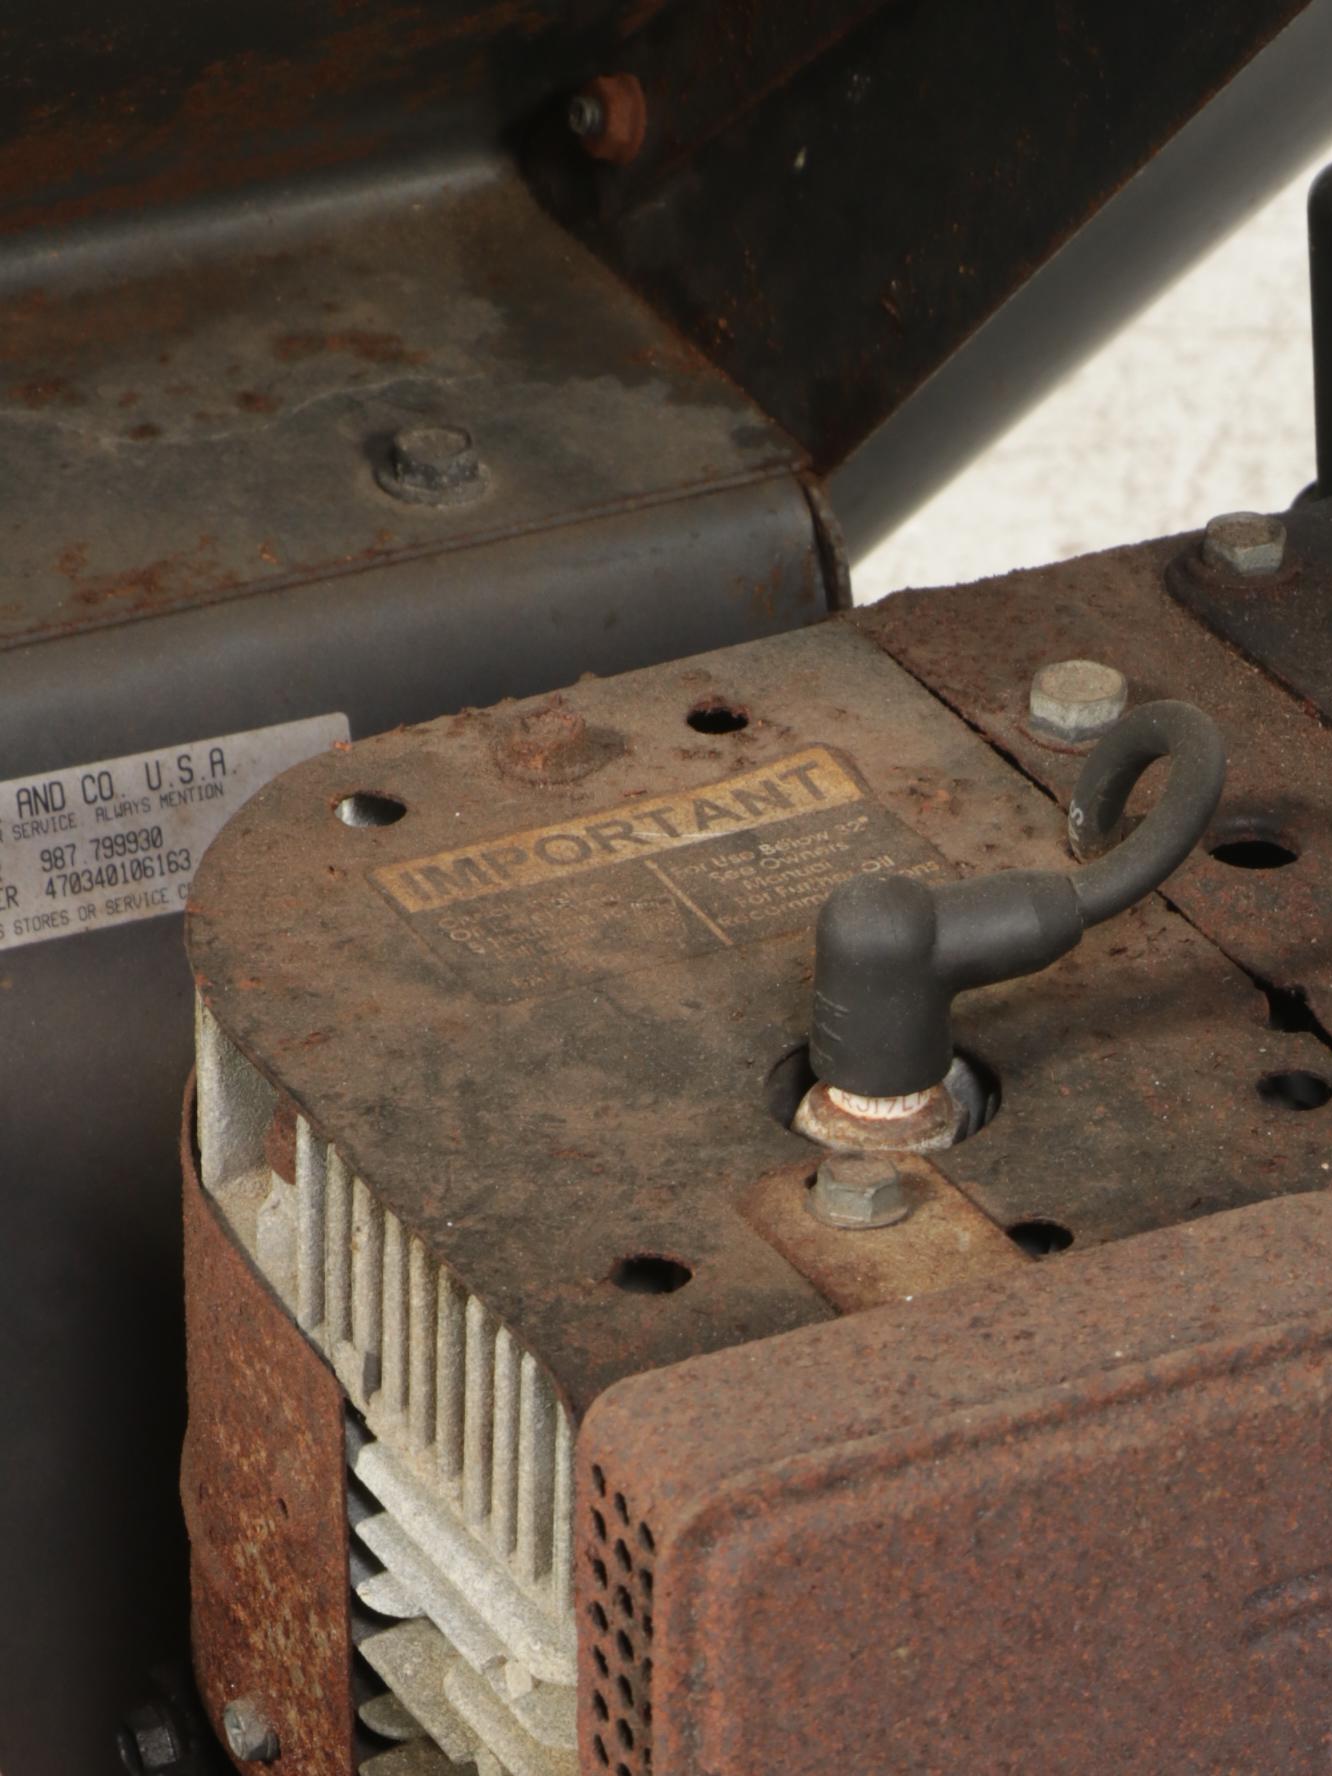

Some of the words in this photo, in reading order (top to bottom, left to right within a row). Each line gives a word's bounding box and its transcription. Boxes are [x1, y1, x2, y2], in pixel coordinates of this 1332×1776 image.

[16, 780, 67, 820] AND
[81, 770, 126, 806] CO.
[145, 747, 238, 792] U.S.A.
[95, 799, 151, 824] ALWAYS
[160, 782, 225, 809] MENTION
[402, 760, 822, 899] IMPORTANT
[711, 851, 755, 868] Use
[758, 831, 830, 855] Below
[45, 849, 192, 900] 470340106163
[709, 866, 757, 883] See
[760, 841, 850, 871] Owners
[743, 861, 833, 890] Manual
[861, 855, 896, 874] Oil
[13, 909, 71, 936] STORES
[78, 903, 97, 922] OR
[106, 888, 170, 917] SERVICE
